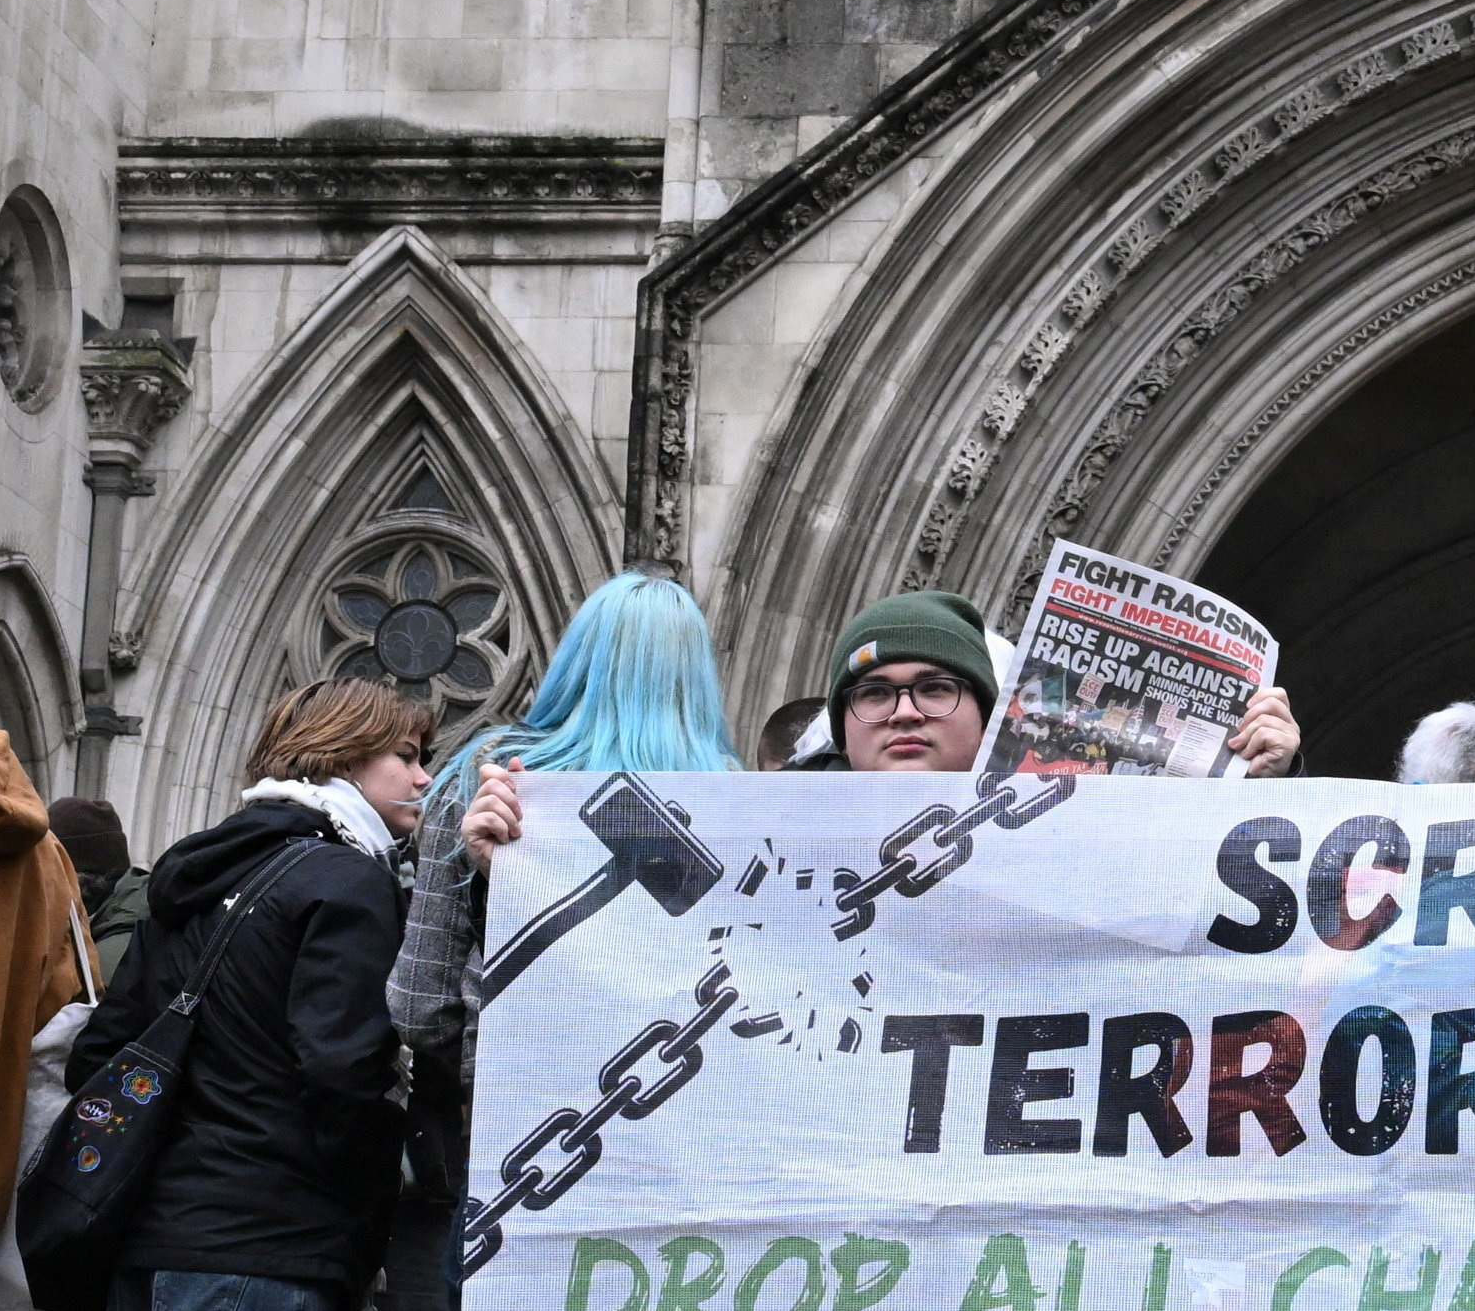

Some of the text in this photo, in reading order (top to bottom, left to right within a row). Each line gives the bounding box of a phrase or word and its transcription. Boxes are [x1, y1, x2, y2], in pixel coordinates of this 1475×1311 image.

[1050, 577, 1118, 613] FIGHT
[1119, 598, 1265, 670] IMPERIALISM!
[1057, 550, 1151, 602] FIGHT
[1152, 581, 1269, 656] RACISM!
[1031, 636, 1146, 694] RACISM
[1040, 613, 1101, 651] RISE
[1105, 632, 1141, 661] UP
[1141, 650, 1255, 704] AGAINST
[1148, 674, 1232, 711] MINNEAPOLIS
[1145, 686, 1242, 728] SHOWS THE WAY
